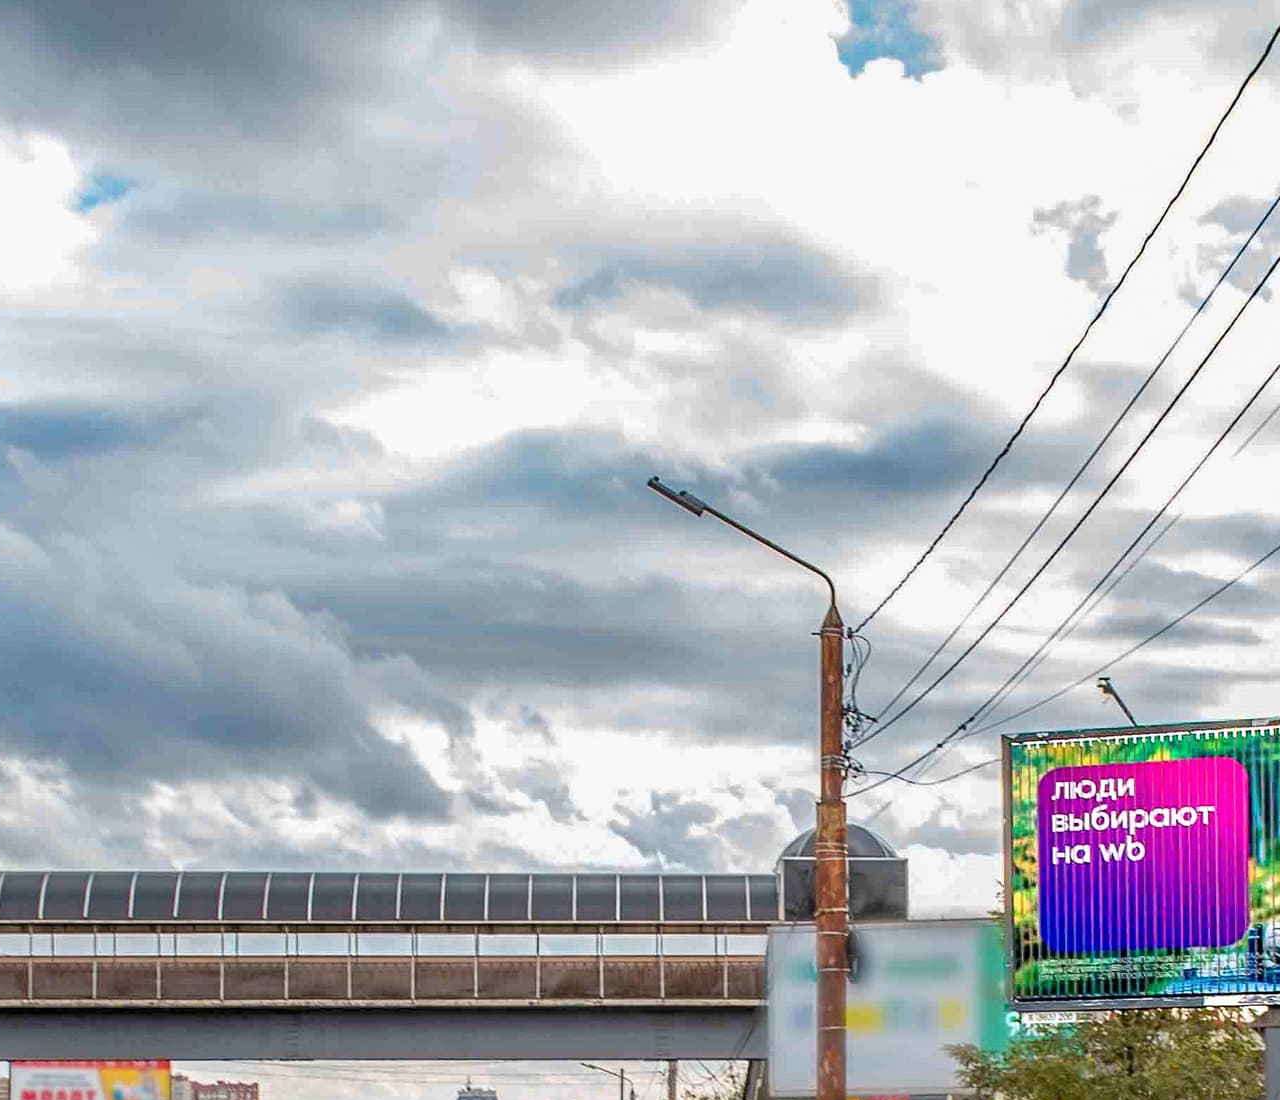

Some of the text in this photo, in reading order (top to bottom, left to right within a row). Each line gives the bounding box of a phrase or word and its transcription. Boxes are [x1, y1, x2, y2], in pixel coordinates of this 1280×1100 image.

[1051, 777, 1135, 802] люди
[1051, 804, 1216, 835] выбирают
[1052, 835, 1146, 865] на wb
